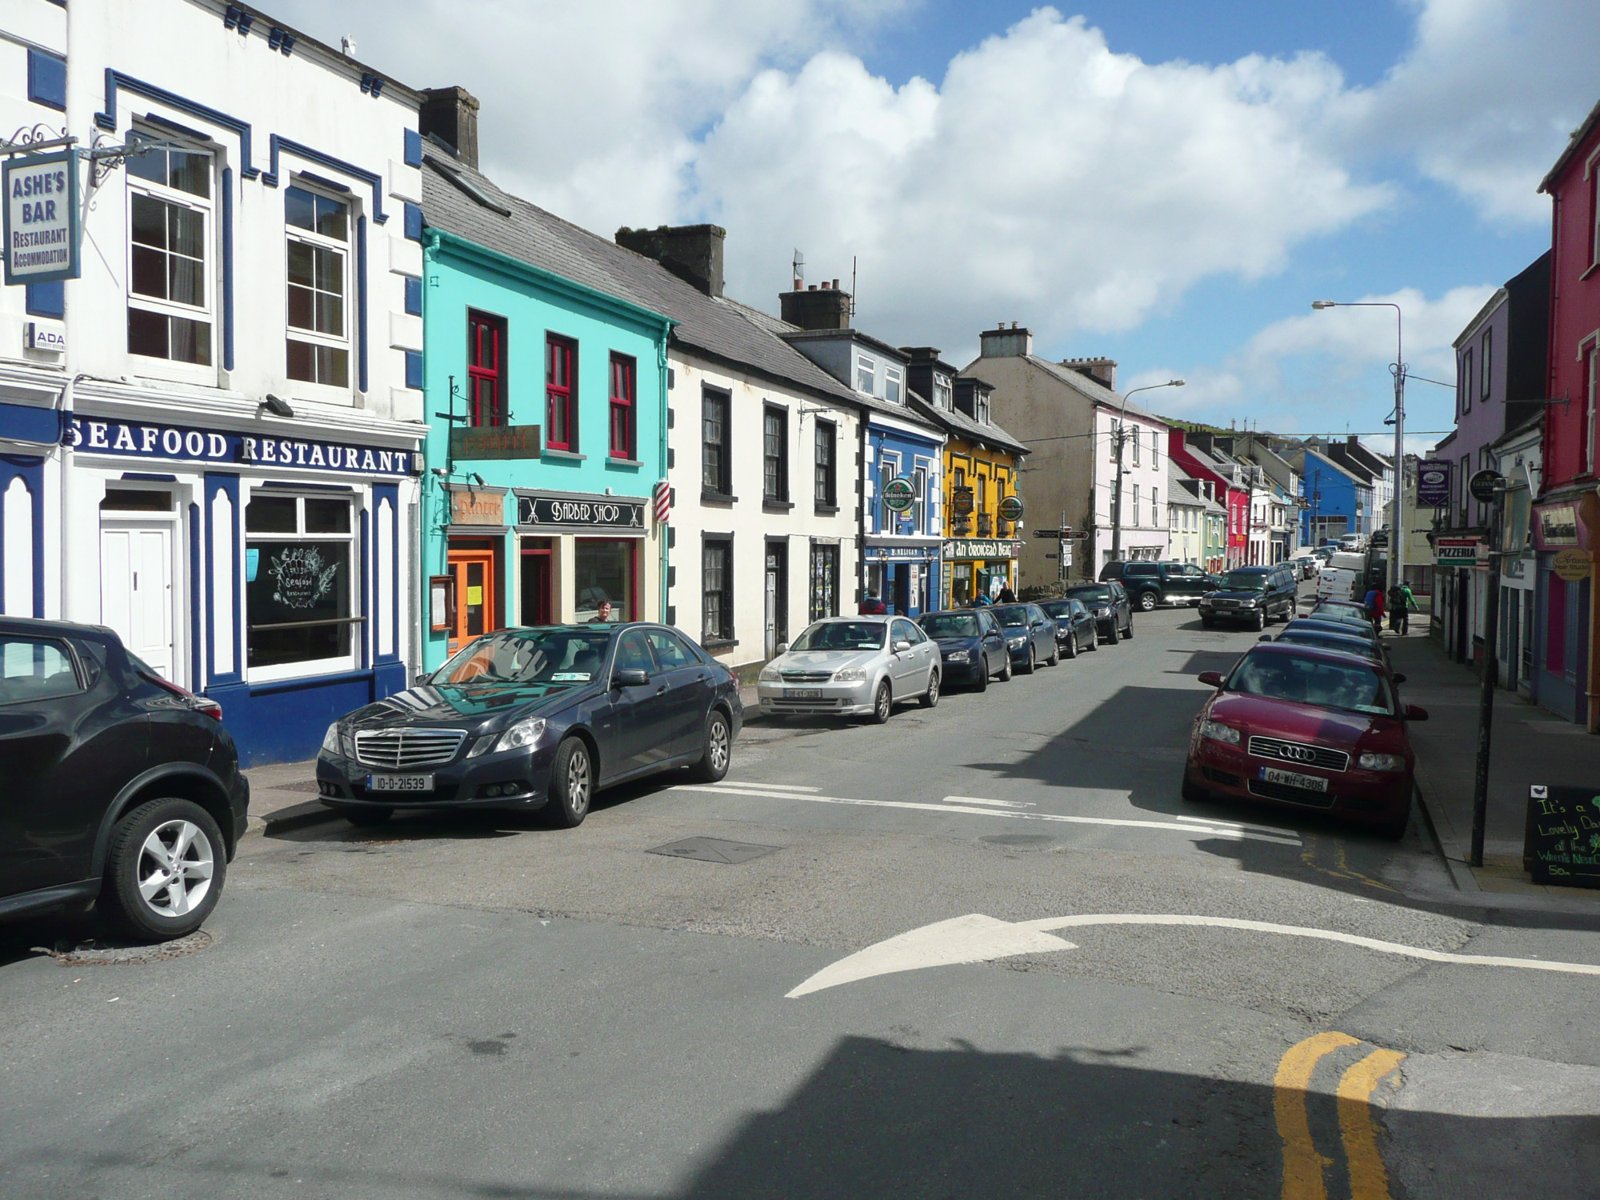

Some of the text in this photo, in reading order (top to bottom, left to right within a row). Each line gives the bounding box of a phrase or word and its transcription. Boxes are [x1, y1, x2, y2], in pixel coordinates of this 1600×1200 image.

[12, 170, 66, 199] ASHE'S
[22, 200, 56, 224] BAR
[13, 228, 68, 249] RESTAURANT
[13, 248, 68, 268] ACCOMMODATION
[72, 418, 408, 473] SEAFOOD RESTAURANT
[551, 501, 620, 523] BARBER SHOP
[1438, 547, 1476, 558] PIZZERIA
[377, 777, 425, 790] 10-D-21539
[1537, 799, 1586, 815] It's a
[1538, 819, 1580, 840] Lovely
